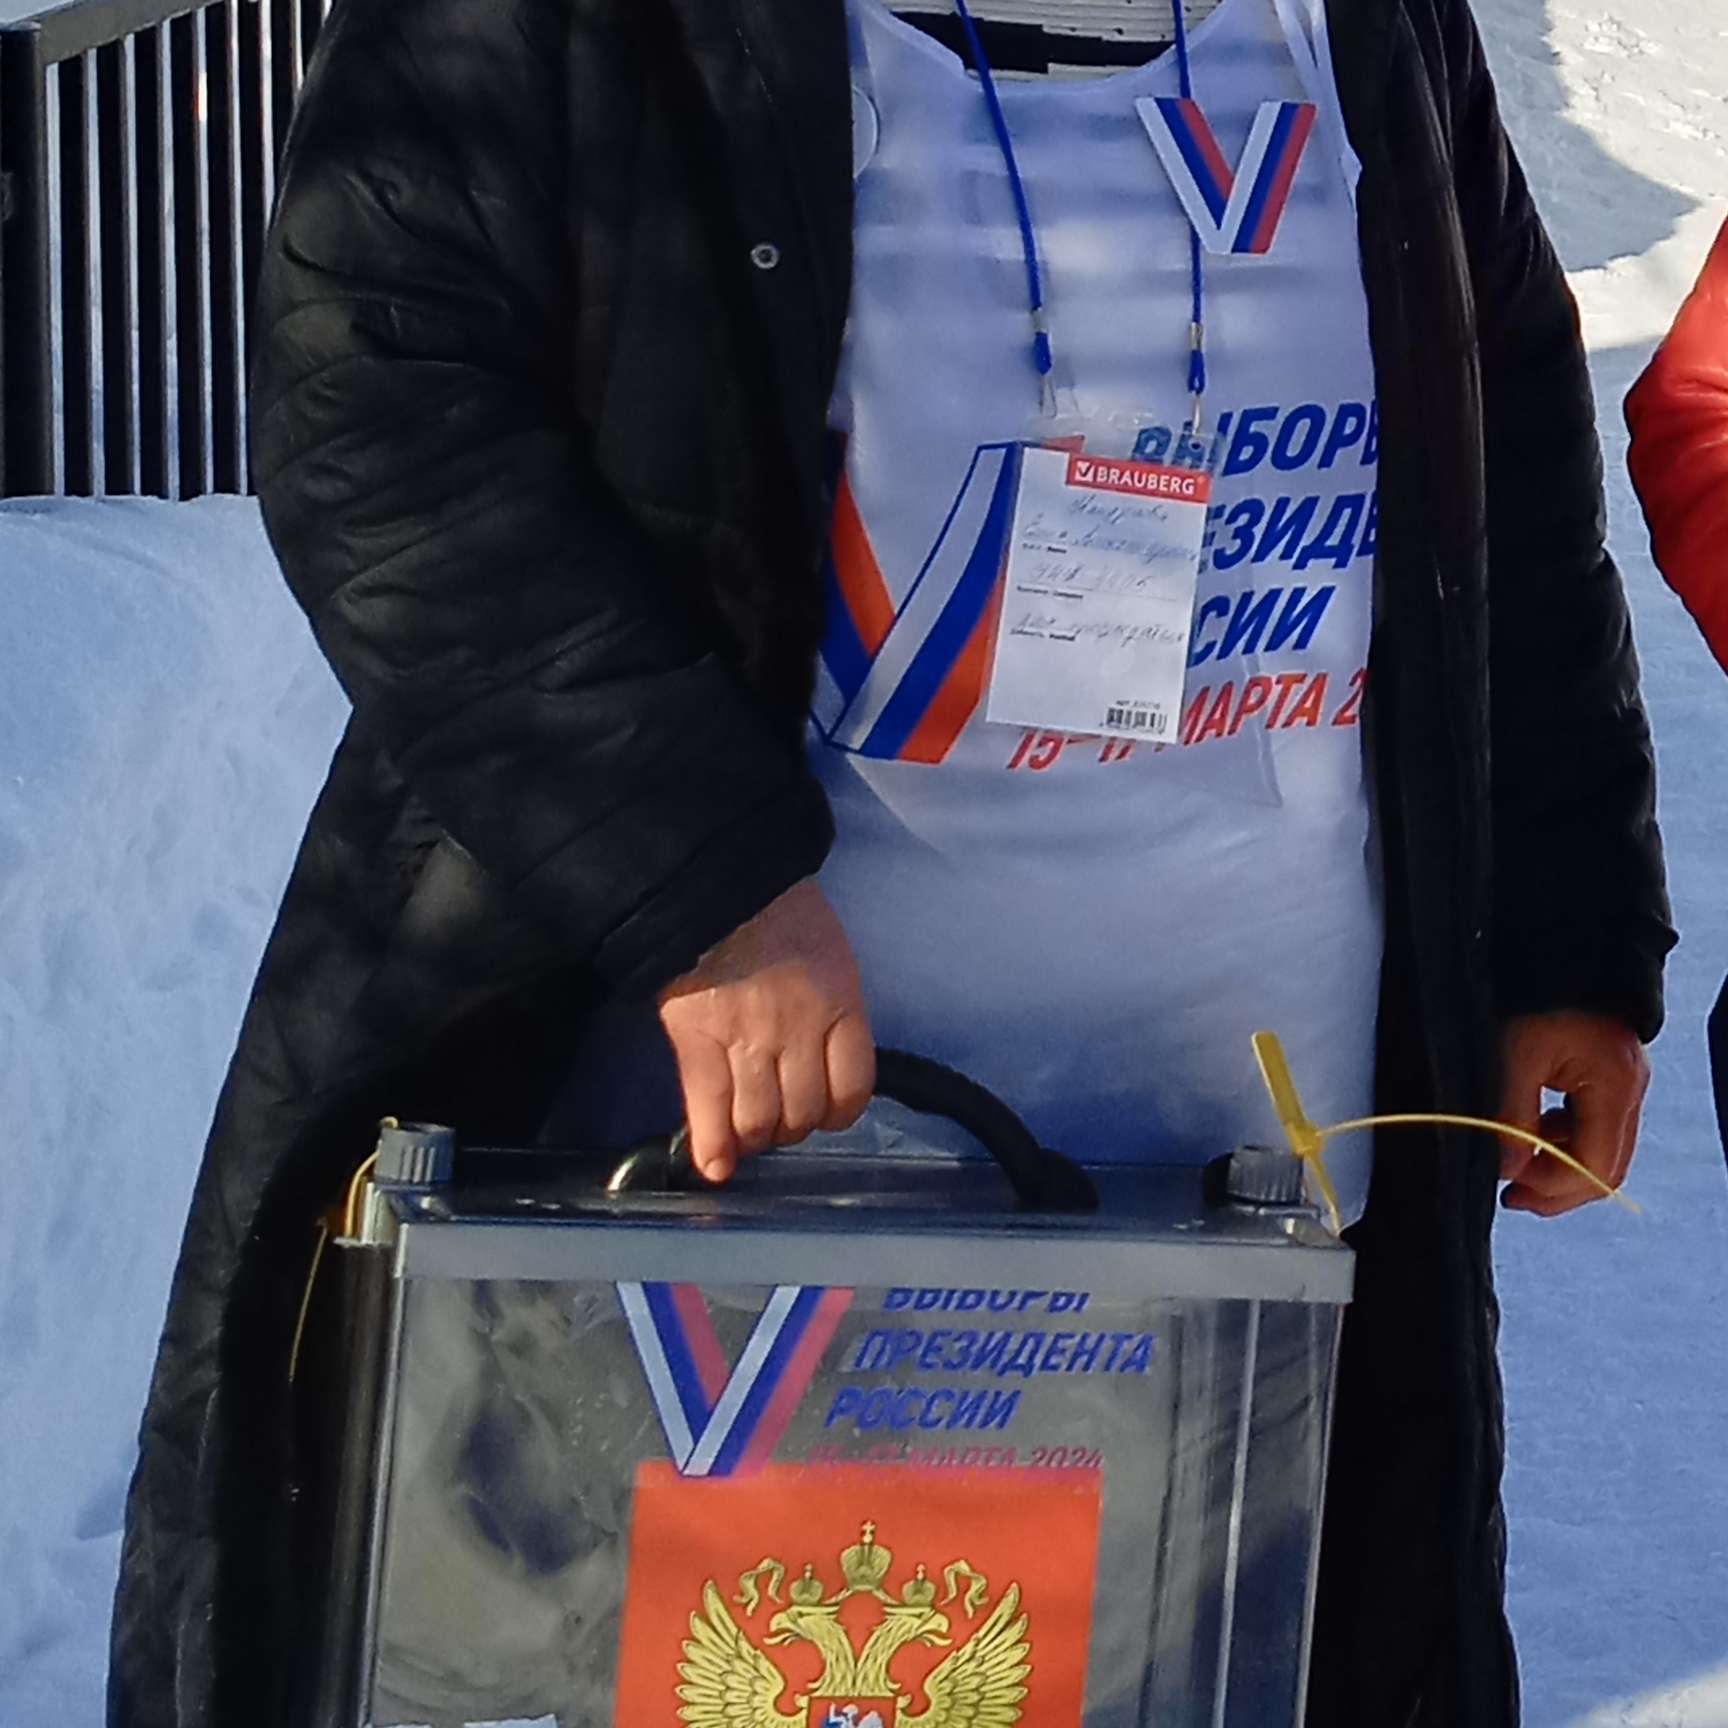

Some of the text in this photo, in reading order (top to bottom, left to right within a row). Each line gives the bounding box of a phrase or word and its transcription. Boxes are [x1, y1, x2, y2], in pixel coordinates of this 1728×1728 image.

[1097, 466, 1196, 495] BRAUBERG
[1186, 586, 1336, 668] СИИ
[854, 1328, 1155, 1378] ПРЕЗИДЕНТА
[824, 1386, 1021, 1431] РОССИИ
